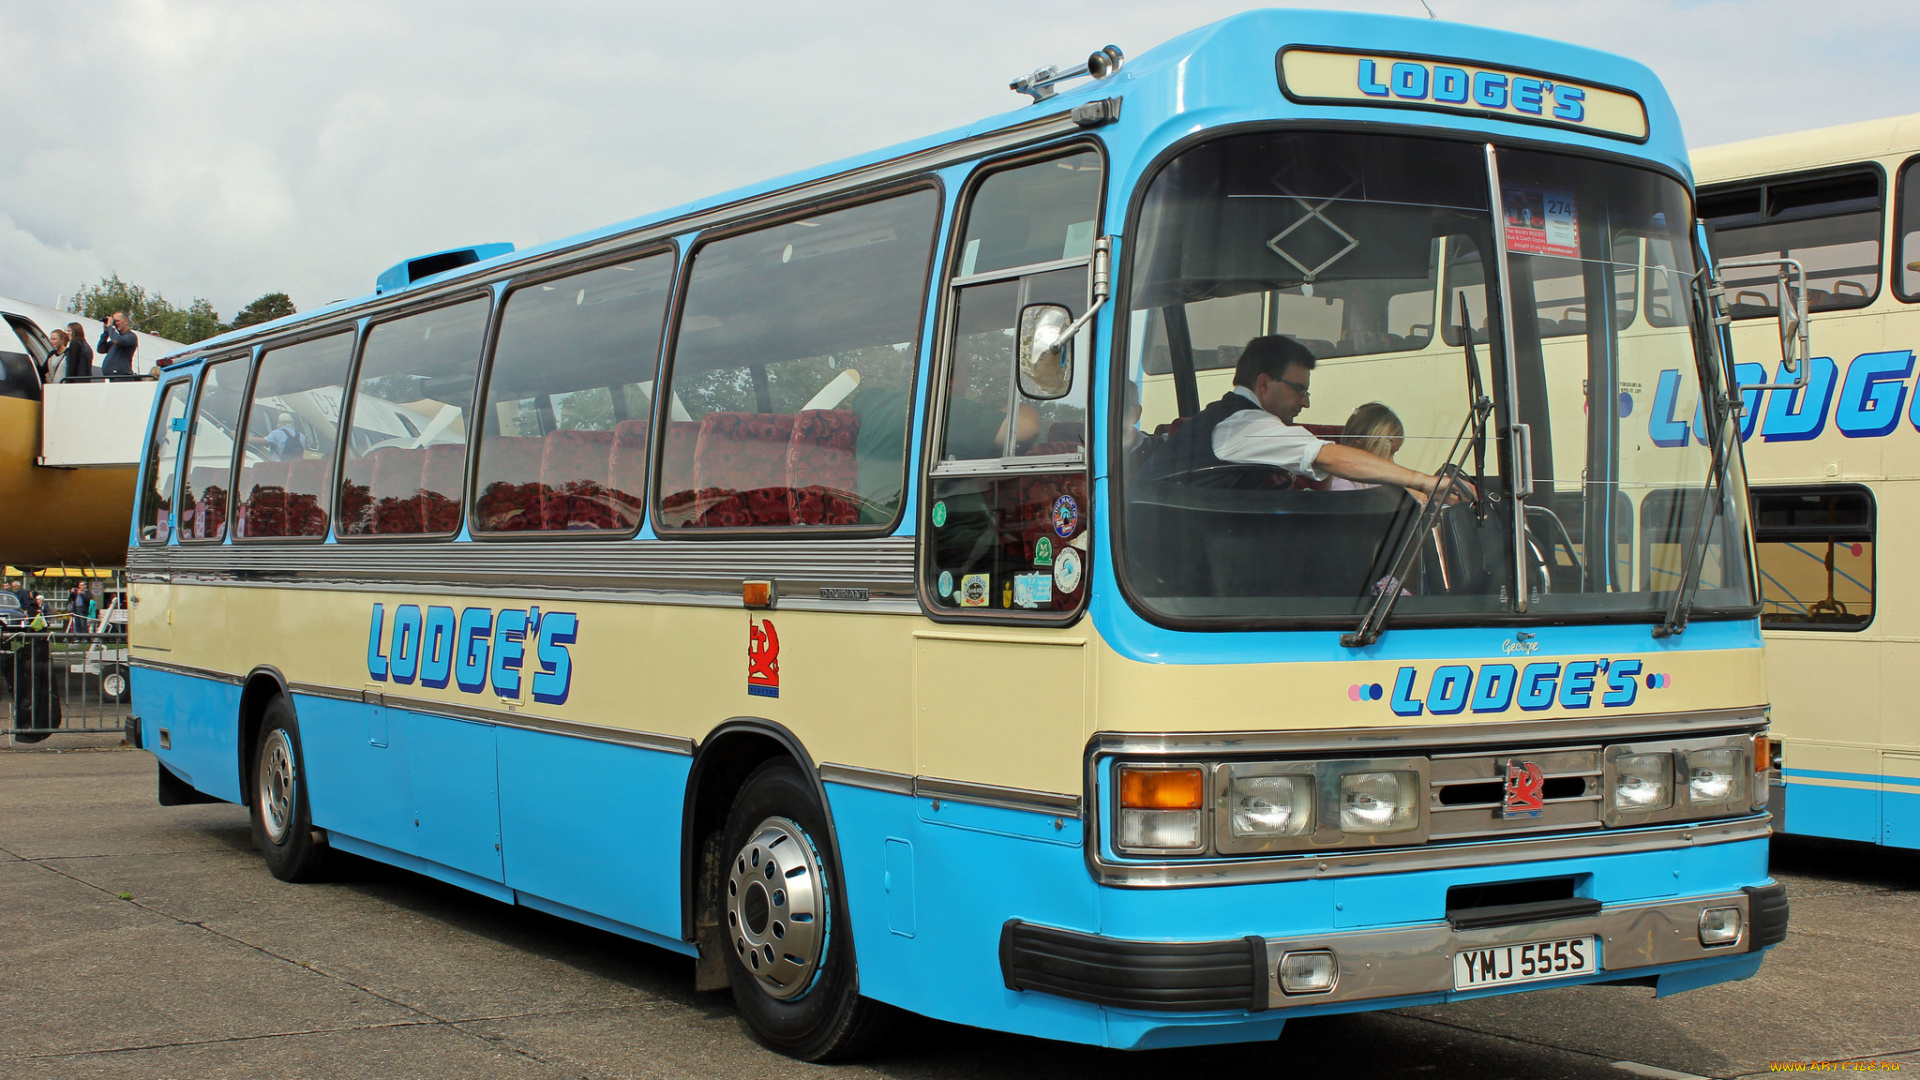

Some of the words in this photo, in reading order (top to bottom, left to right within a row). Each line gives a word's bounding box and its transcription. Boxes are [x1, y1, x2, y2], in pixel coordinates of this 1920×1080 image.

[1358, 59, 1585, 122] LODGE'S
[1547, 200, 1572, 216] 274
[1648, 349, 1920, 448] LODG
[367, 603, 579, 705] LODGE'S
[1502, 638, 1540, 655] George
[1390, 658, 1642, 717] LODGE'S
[1463, 948, 1513, 983] YMJ
[1521, 939, 1585, 976] 555S
